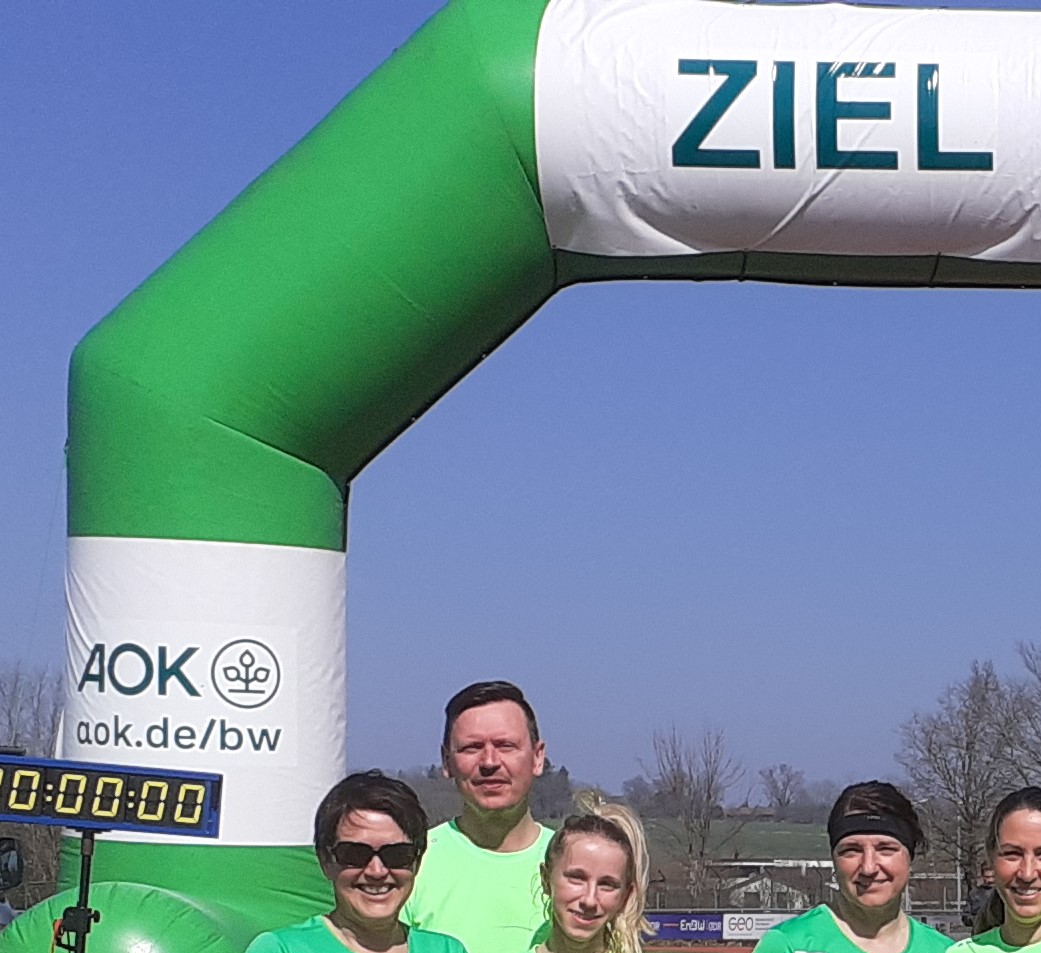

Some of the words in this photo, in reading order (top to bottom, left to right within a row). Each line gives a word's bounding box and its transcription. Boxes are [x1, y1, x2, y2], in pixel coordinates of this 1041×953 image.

[672, 59, 993, 171] ZIEL
[77, 642, 201, 697] AOK
[77, 715, 282, 752] aok.de/bw
